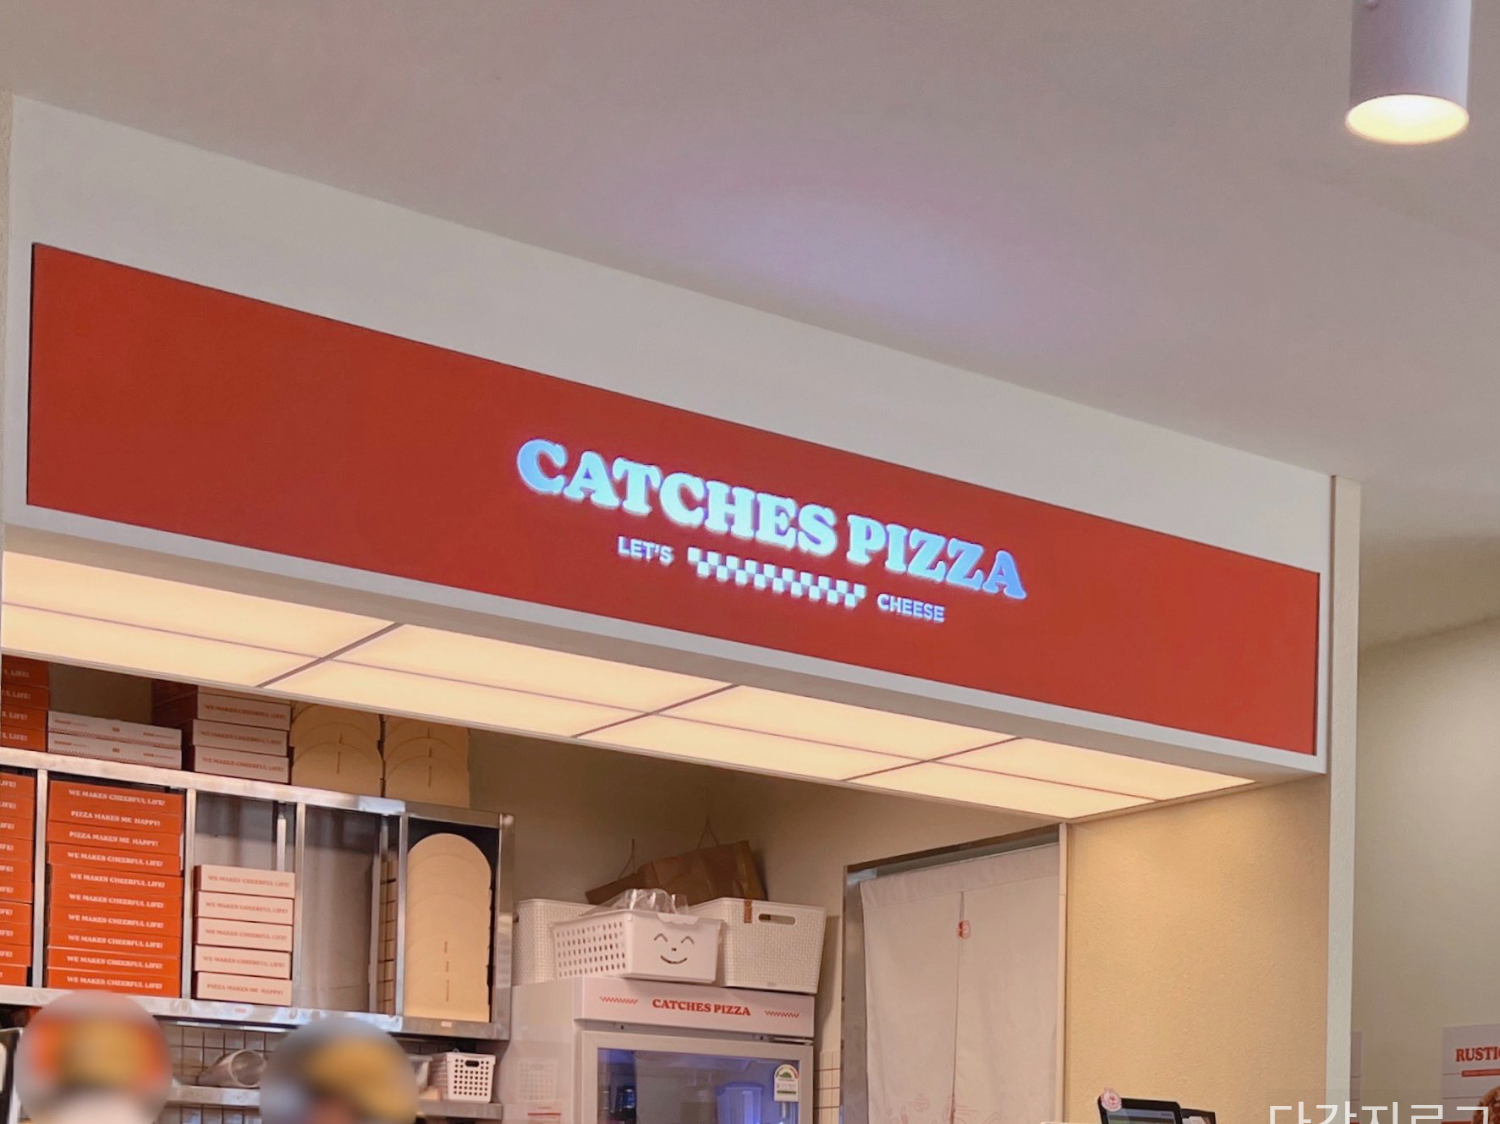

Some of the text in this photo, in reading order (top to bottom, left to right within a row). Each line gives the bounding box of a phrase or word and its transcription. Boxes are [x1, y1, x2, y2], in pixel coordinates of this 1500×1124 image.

[517, 438, 1027, 600] CATCHES PIZZA
[617, 535, 945, 623] LET'S CHEESE
[70, 810, 93, 820] PIZZA
[94, 812, 120, 822] MAKES
[121, 815, 132, 824] ME
[69, 831, 91, 841] PIZZA
[92, 833, 118, 843] MAKES
[119, 836, 130, 845] ME
[67, 852, 79, 860] WE
[80, 853, 106, 862] MAKES
[145, 858, 163, 867] LIFE!
[70, 873, 82, 881] WE
[83, 874, 108, 883] MAKES
[147, 879, 165, 888] LIFE!
[69, 893, 81, 901] WE
[81, 894, 107, 904] MAKES
[146, 900, 164, 909] LIFE!
[68, 914, 80, 922] WE
[81, 915, 107, 924] MAKES
[146, 920, 164, 929] LIFE!
[68, 934, 80, 942] WE
[80, 935, 106, 944] MAKES
[145, 940, 163, 949] LIFE!
[67, 955, 79, 963] WE
[80, 956, 106, 965] MAKES
[144, 961, 163, 969] LIFE!
[67, 976, 79, 984] WE
[80, 976, 106, 985] MAKES
[144, 981, 163, 989] LIFE!
[652, 998, 751, 1016] CATCHES PIZZA
